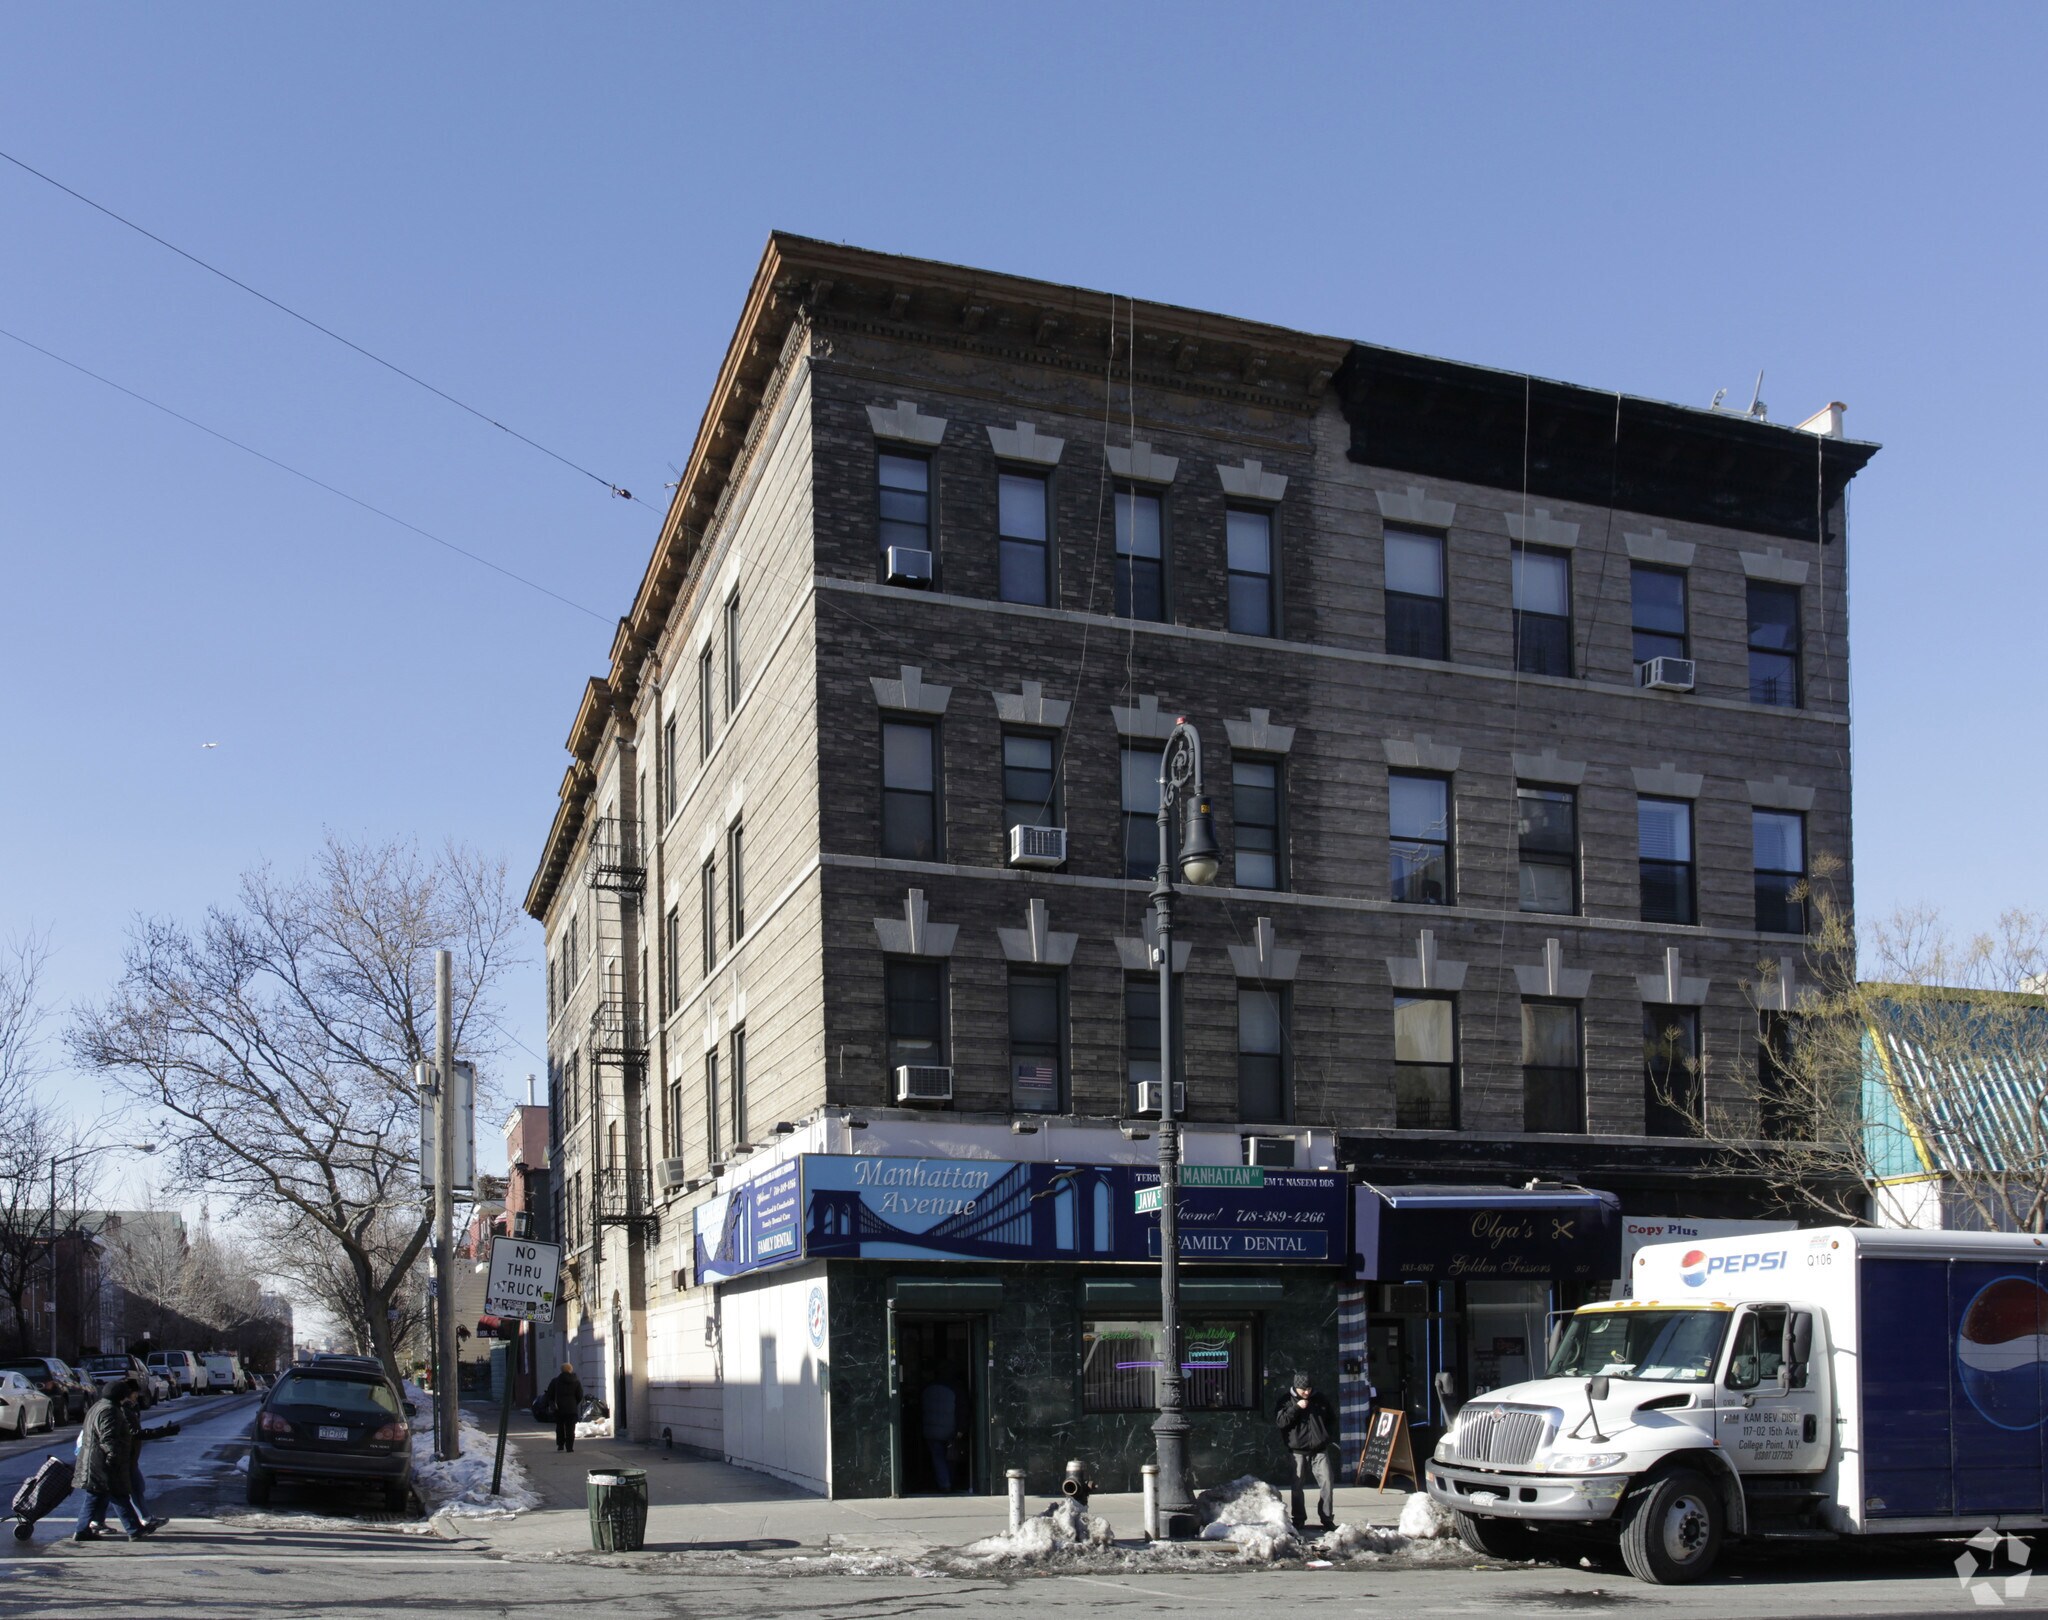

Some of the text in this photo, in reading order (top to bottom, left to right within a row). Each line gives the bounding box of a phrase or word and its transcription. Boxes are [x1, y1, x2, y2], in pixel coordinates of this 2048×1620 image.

[855, 1159, 990, 1190] Manhattan
[1183, 1167, 1250, 1185] MANHATTAN
[1286, 1178, 1317, 1187] NASEEM
[1319, 1179, 1335, 1188] DDS
[879, 1191, 977, 1216] Avenue
[1137, 1191, 1157, 1210] JAVA
[1236, 1209, 1325, 1223] 718-389-4266
[1471, 1210, 1534, 1250] Olga's
[1627, 1224, 1699, 1236] Copy Plus
[757, 1230, 793, 1255] FAMILY DENTAL
[1244, 1236, 1307, 1251] DENTAL
[515, 1246, 536, 1260] NO
[1807, 1253, 1832, 1266] Q106
[507, 1262, 542, 1279] THRU
[1448, 1253, 1551, 1276] Golden Scissors
[1706, 1250, 1788, 1275] PEPSI
[1744, 1412, 1761, 1422] KAM
[1743, 1426, 1799, 1436] 117-02 15th Ave.
[1739, 1440, 1763, 1452] College
